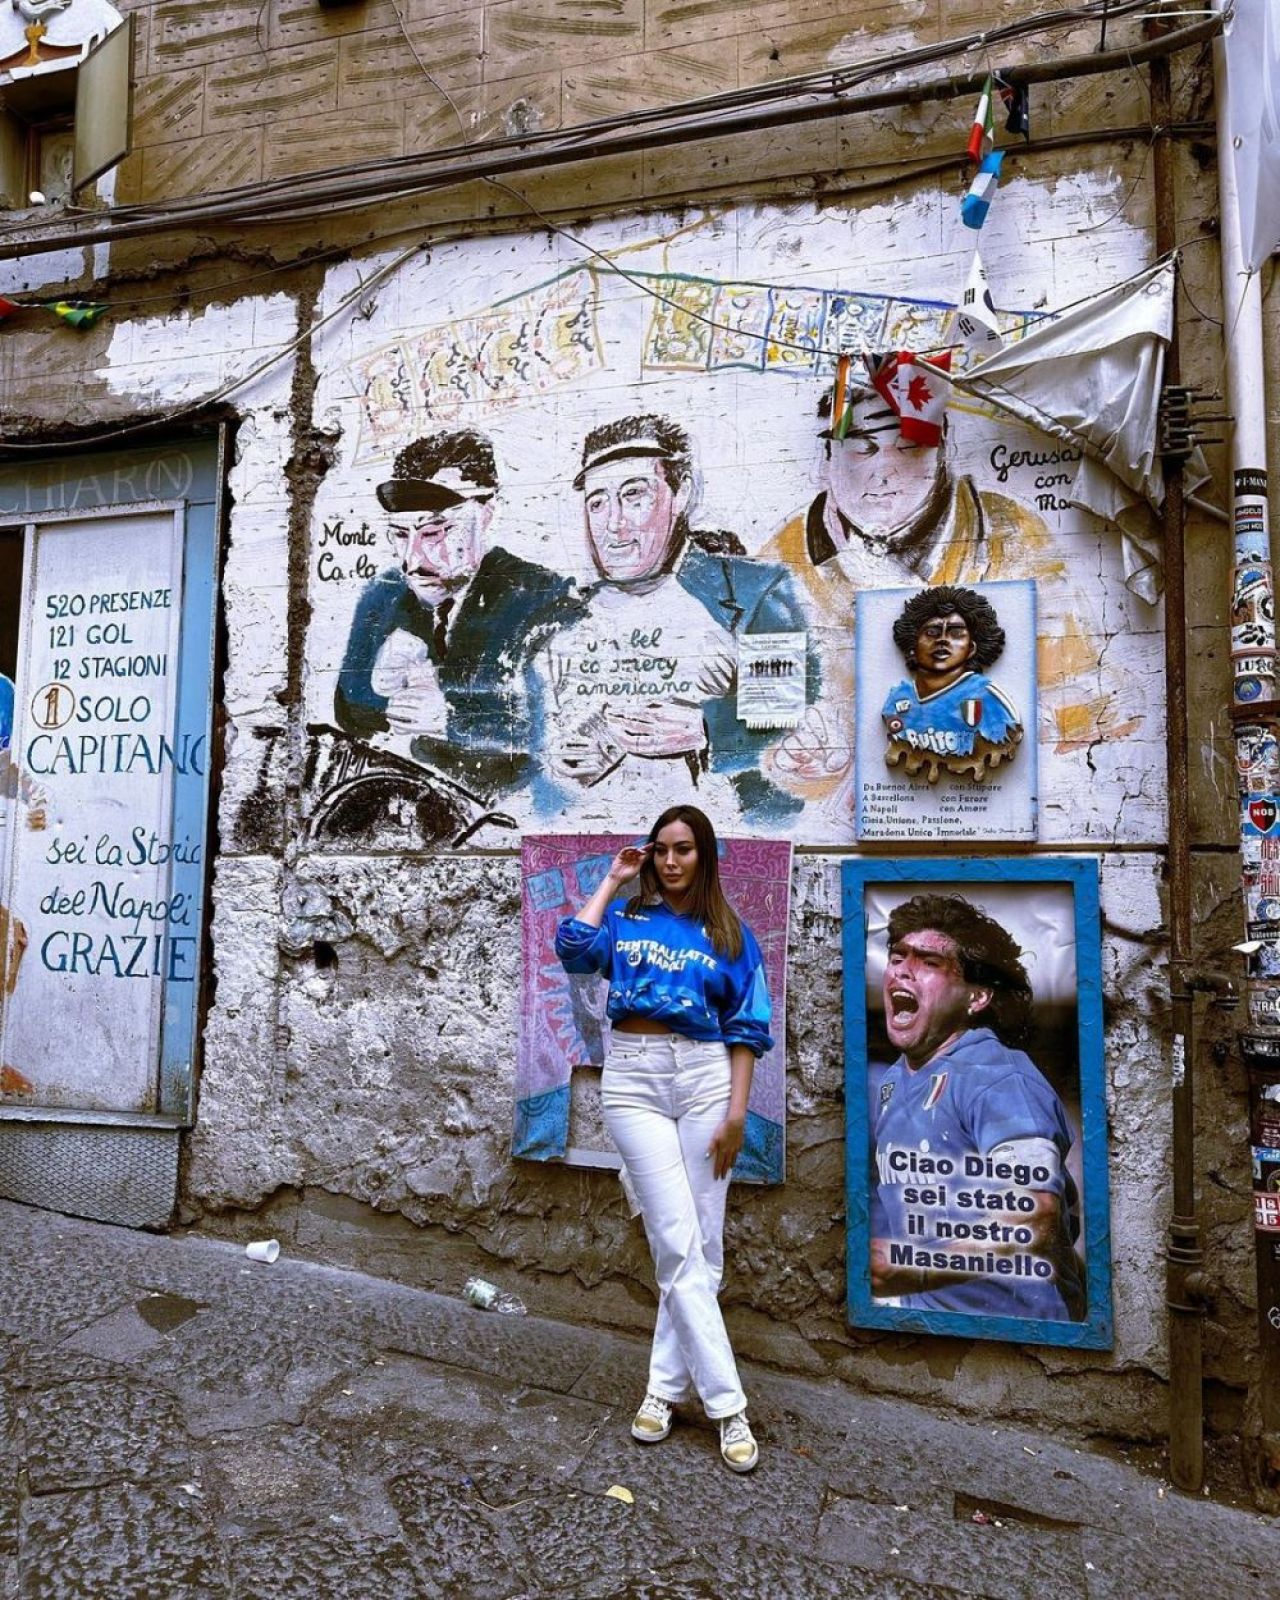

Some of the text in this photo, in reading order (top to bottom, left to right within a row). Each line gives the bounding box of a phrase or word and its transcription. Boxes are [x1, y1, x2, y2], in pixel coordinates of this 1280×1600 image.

[1035, 474, 1072, 489] con
[319, 521, 376, 547] Monte
[317, 552, 378, 581] Carlo
[46, 588, 172, 619] 520 PRESENZE
[50, 623, 134, 649] 121 GOL
[630, 627, 662, 649] bel
[54, 654, 167, 680] 12 STAGIONI
[576, 680, 693, 696] americano
[76, 695, 151, 723] SOLO
[870, 805, 898, 814] Napoli
[45, 833, 90, 866] sei
[95, 833, 123, 867] la
[40, 881, 193, 935] del Napoli
[40, 931, 197, 982] GRAZIE
[616, 940, 717, 970] CENTRALE LATTE
[647, 951, 687, 973] NAPOLI
[889, 1151, 1050, 1185] Ciao Diego
[904, 1186, 1035, 1212] sei stato
[908, 1214, 1032, 1244] il nostro
[890, 1243, 1052, 1278] Masaniello
